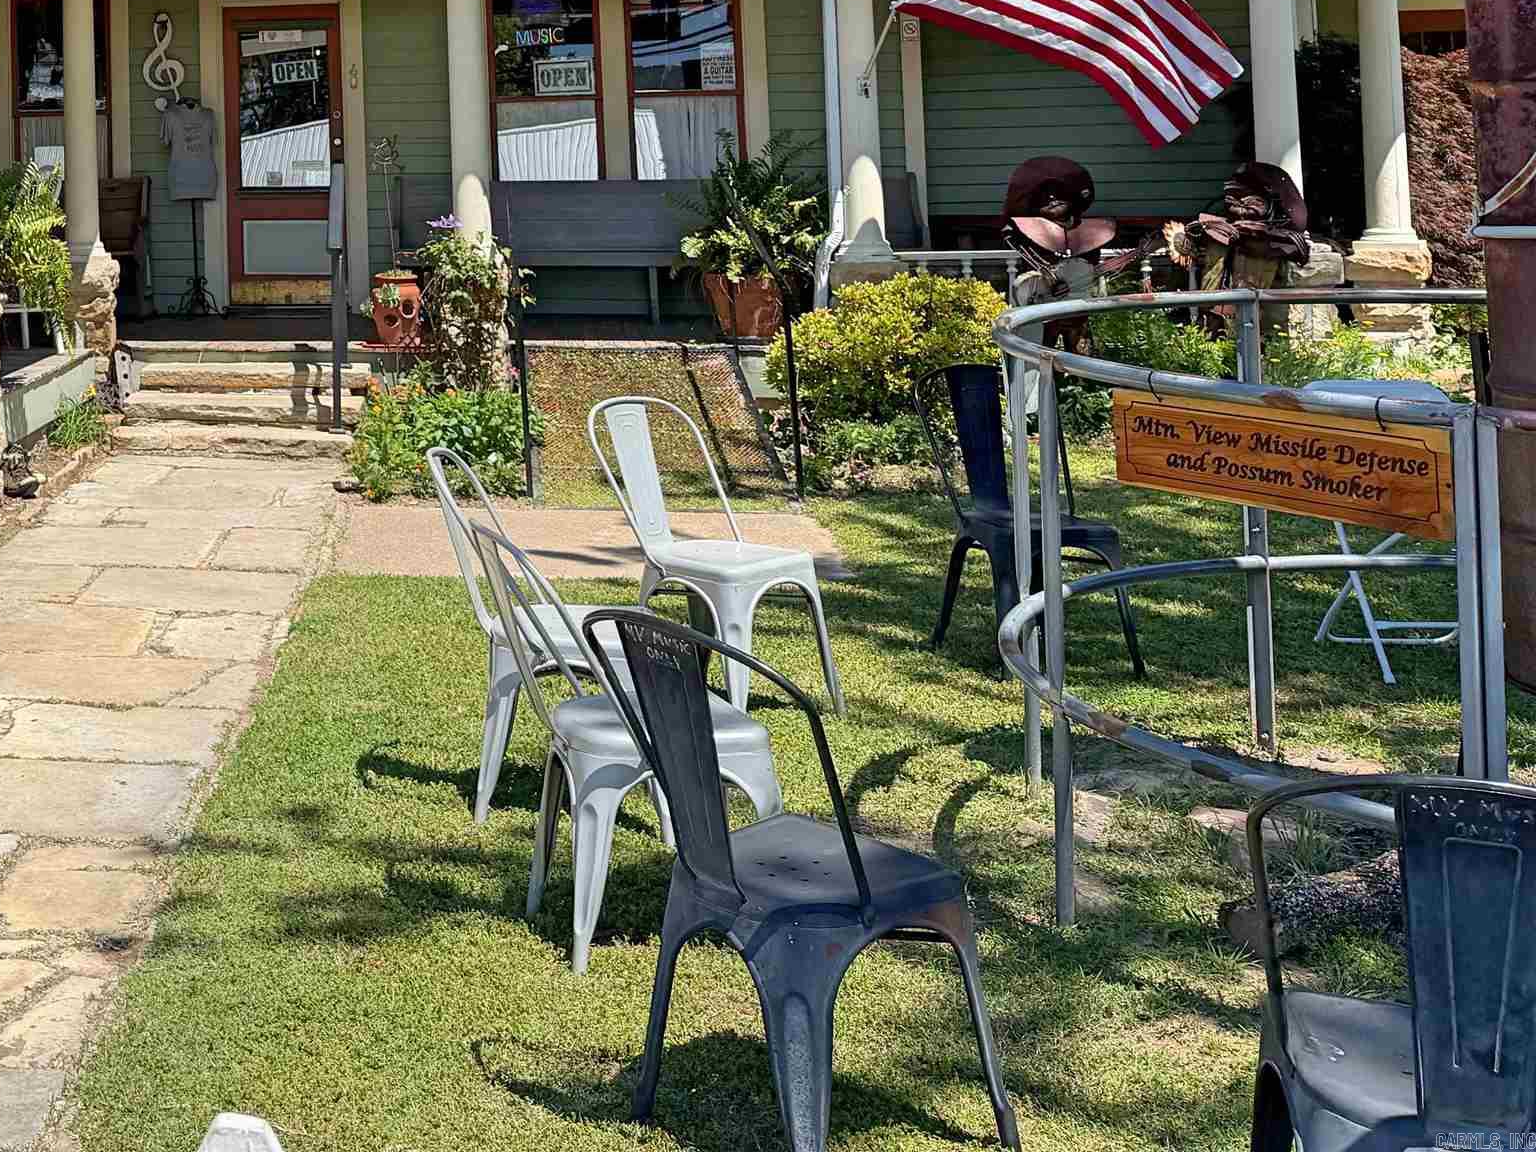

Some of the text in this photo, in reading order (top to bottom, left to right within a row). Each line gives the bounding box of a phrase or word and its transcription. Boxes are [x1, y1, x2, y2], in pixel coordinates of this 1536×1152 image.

[515, 26, 566, 47] MUSIC
[275, 61, 315, 81] OPEN
[539, 67, 587, 88] OPEN
[1132, 415, 1430, 477] Mtn. View Missile Defense
[1166, 450, 1389, 501] and Possum Smoker
